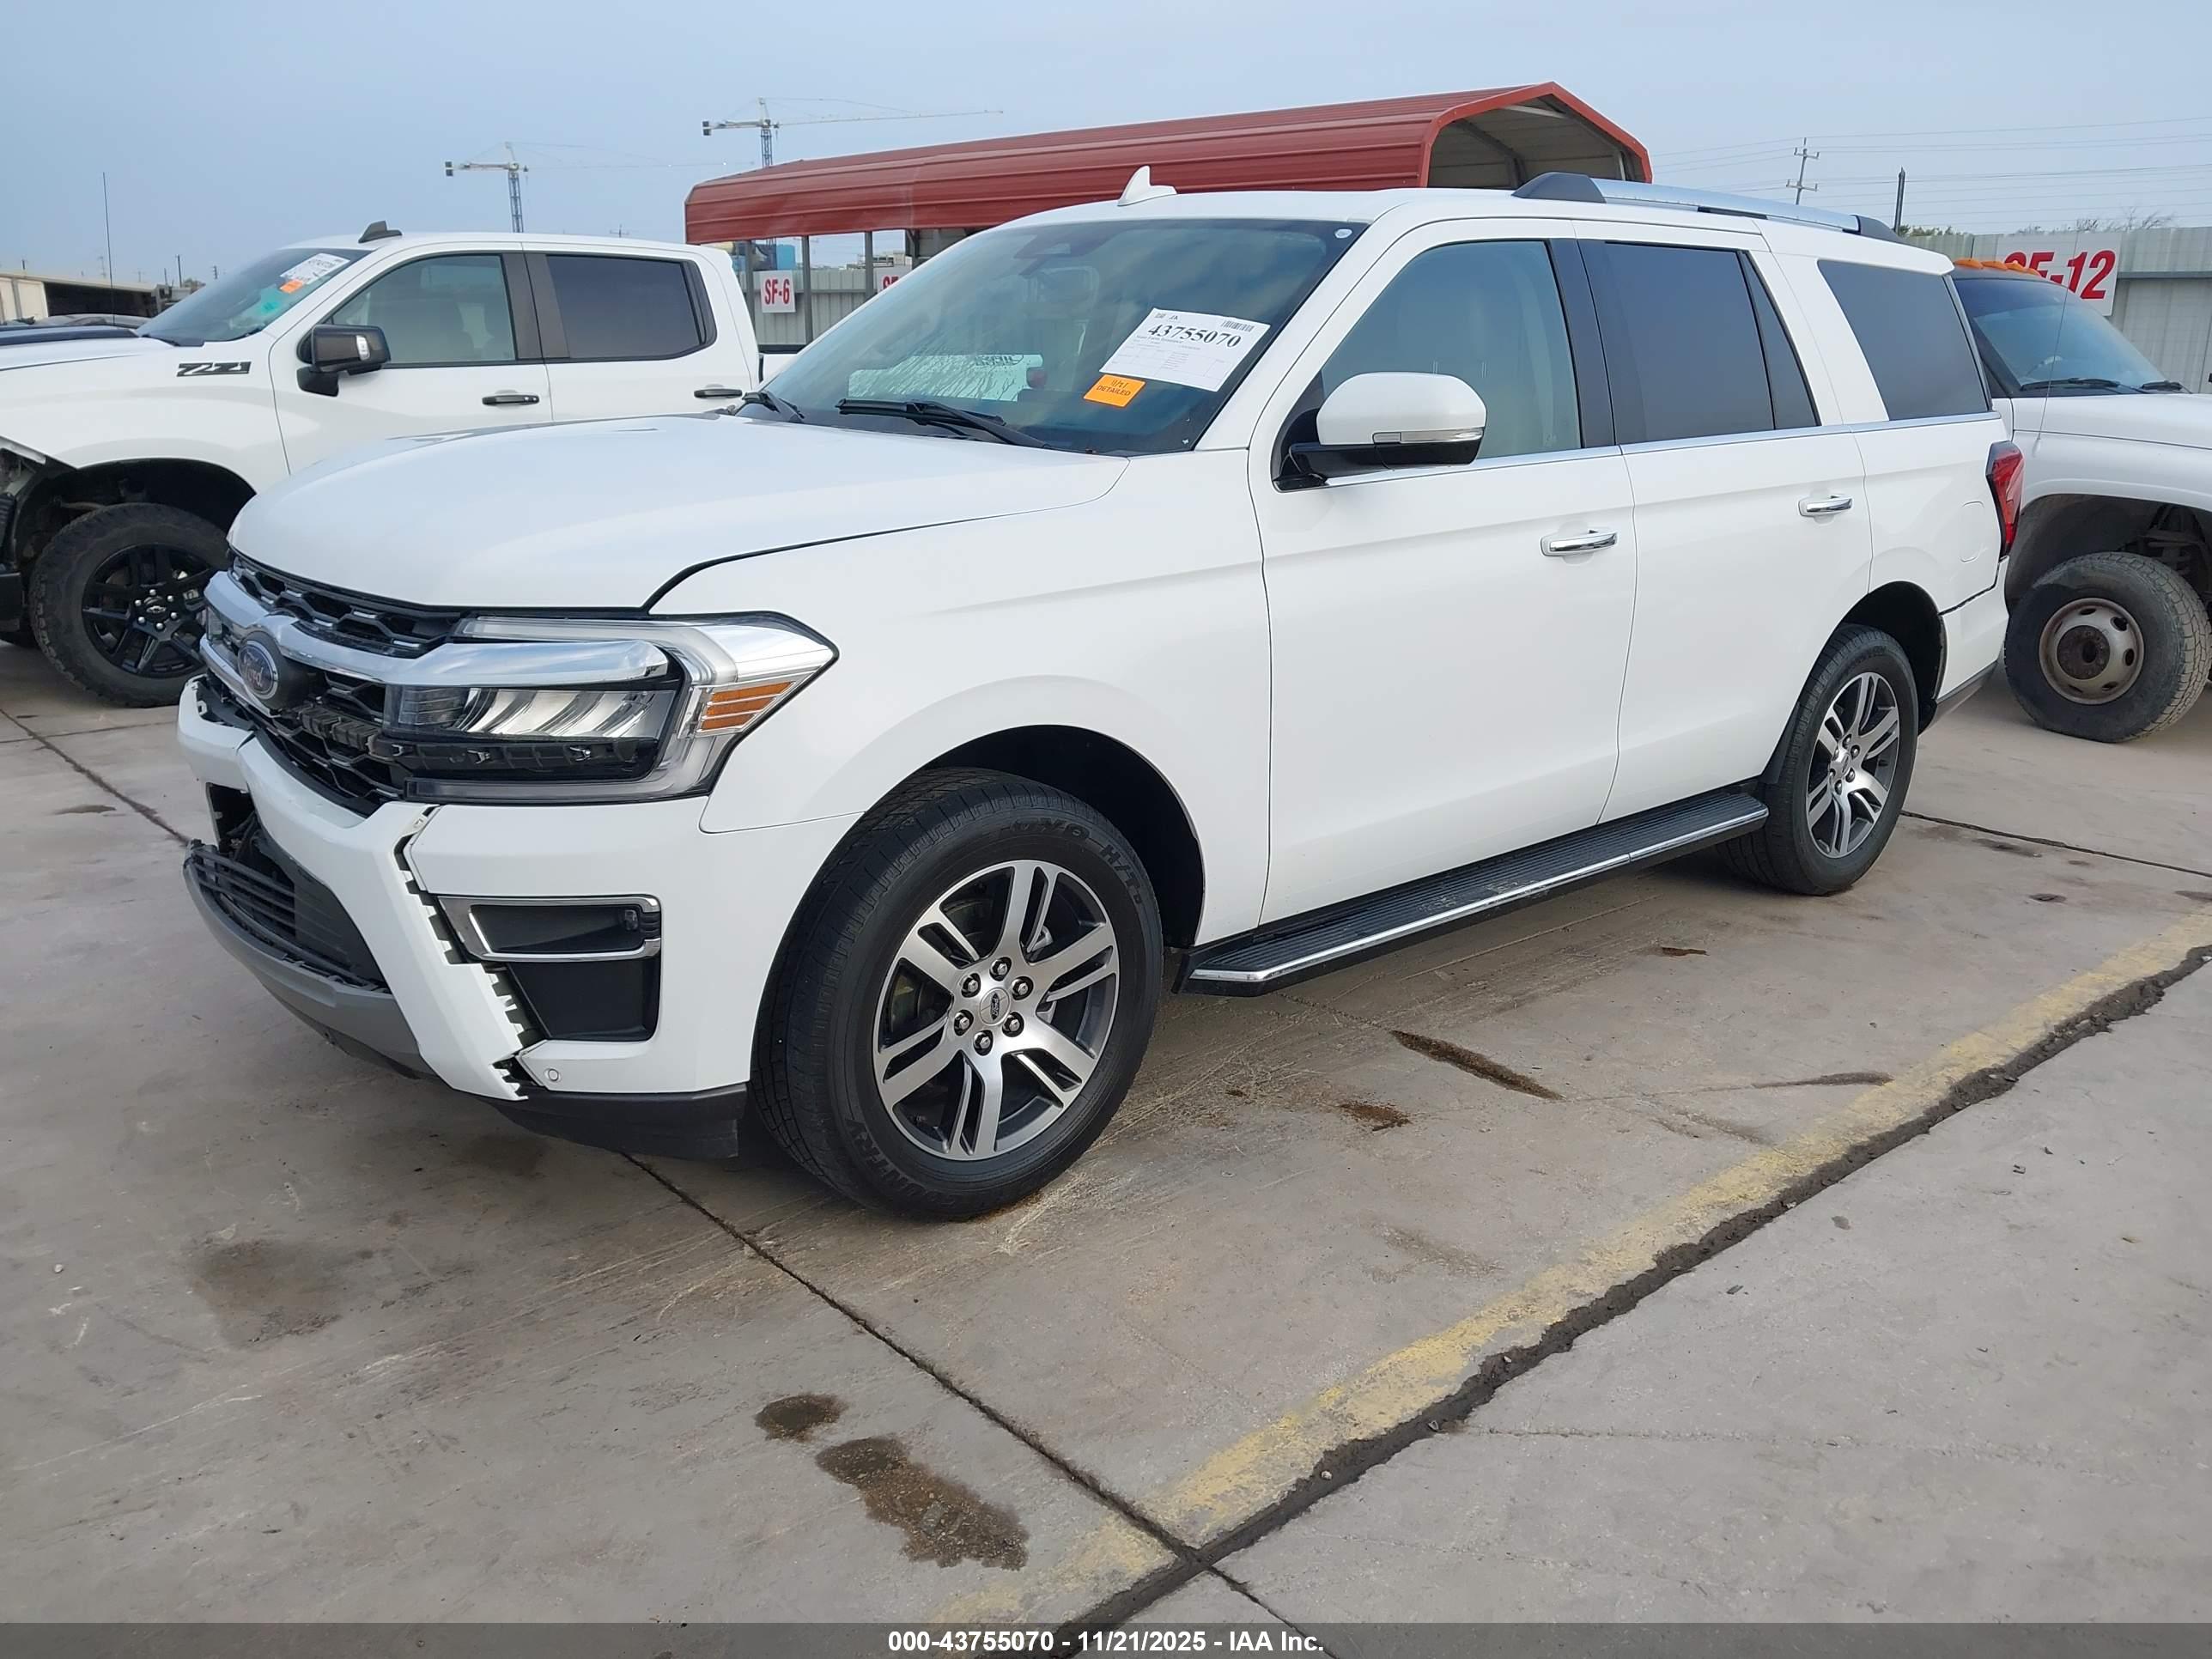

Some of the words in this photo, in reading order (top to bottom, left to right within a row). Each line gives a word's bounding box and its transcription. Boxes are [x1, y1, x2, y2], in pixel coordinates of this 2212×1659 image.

[764, 278, 791, 305] SF-6
[1147, 324, 1243, 348] 43755070
[176, 362, 252, 377] Z71
[1096, 385, 1132, 396] DETAILED
